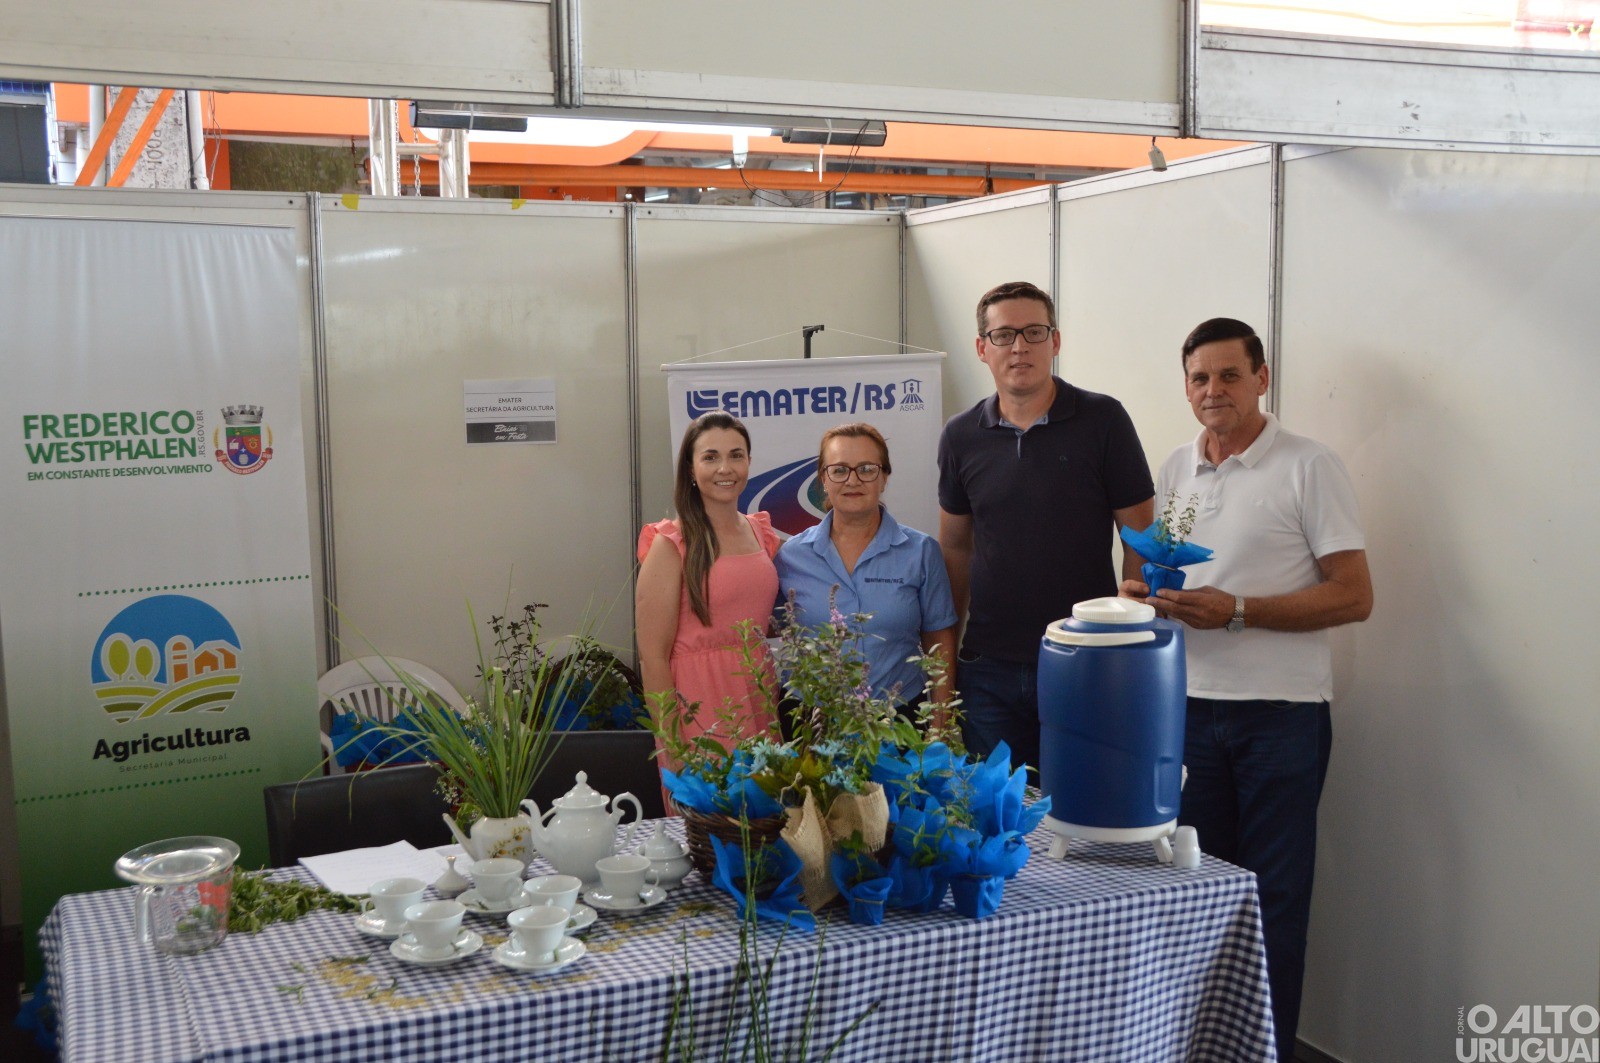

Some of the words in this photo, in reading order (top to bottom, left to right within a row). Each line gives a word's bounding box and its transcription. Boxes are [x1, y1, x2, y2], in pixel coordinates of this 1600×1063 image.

[721, 382, 896, 418] EMATER/RS
[23, 410, 195, 439] FREDERICO
[25, 437, 197, 464] WESTPHALEN
[28, 471, 44, 481] EM
[45, 468, 111, 480] CONSTANTE
[113, 464, 213, 477] DESENVOLVIMENTO
[93, 726, 251, 762] Agricultura
[119, 761, 173, 773] Secretaria
[178, 753, 227, 765] Municipal
